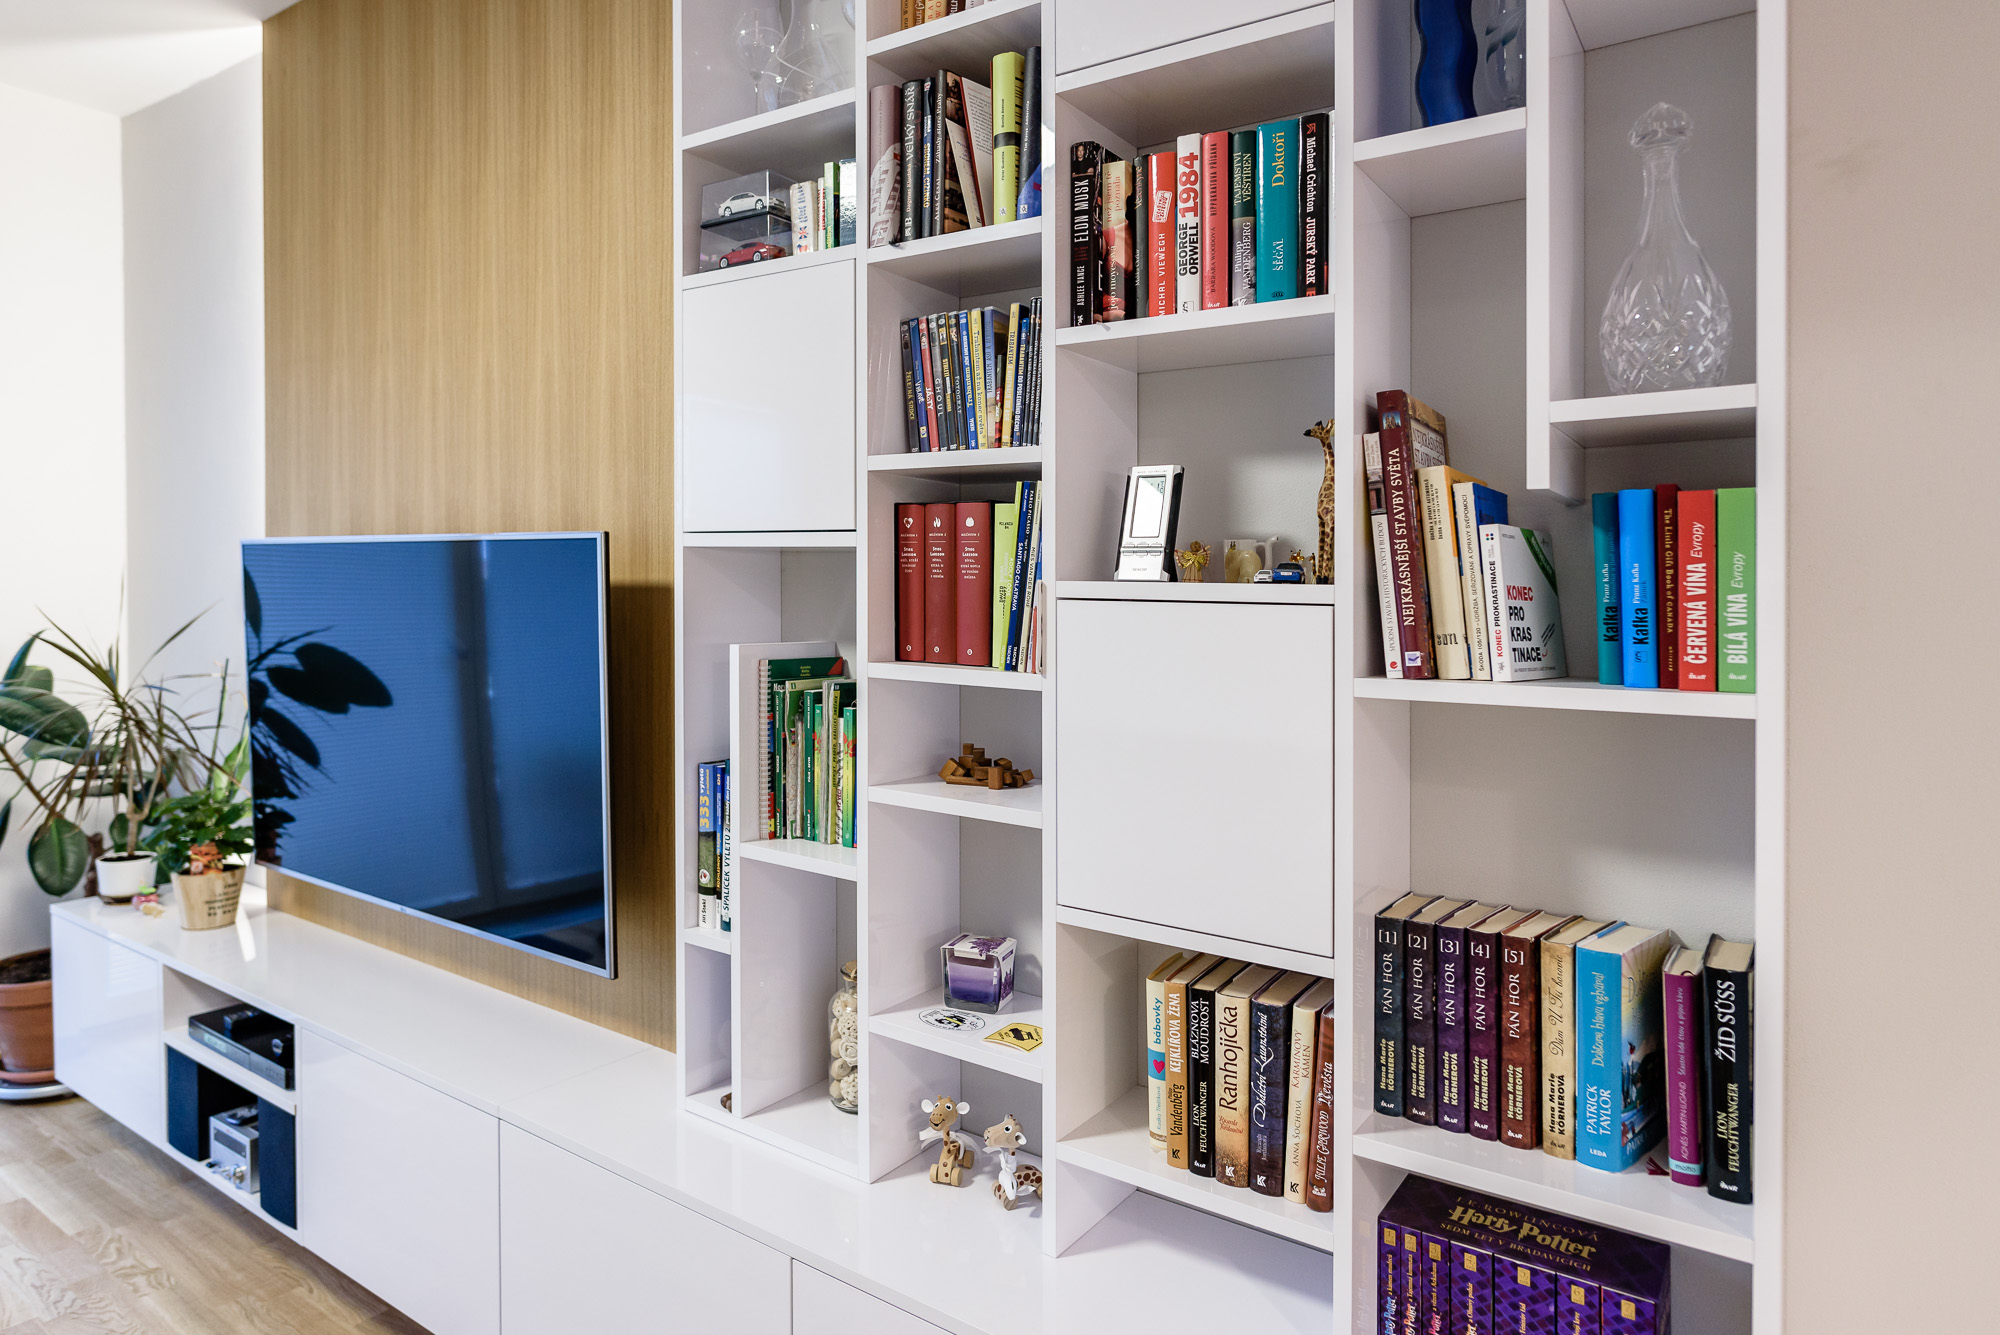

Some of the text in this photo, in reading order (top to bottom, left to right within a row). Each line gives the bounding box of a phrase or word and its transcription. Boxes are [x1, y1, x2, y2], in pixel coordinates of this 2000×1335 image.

[1178, 152, 1199, 218] 1984
[1232, 152, 1242, 206] TAJEMSTVÍ
[1241, 152, 1252, 202] VĚŠTÍREN
[1271, 131, 1286, 188] Doktoři
[1074, 179, 1089, 211] MUSK
[1112, 175, 1123, 211] poznala
[1305, 136, 1318, 285] Michael Crichton JURSKÝ PARK
[1074, 215, 1089, 242] ELON
[1178, 222, 1188, 277] GEORGE
[1188, 222, 1199, 276] ORWELL
[1275, 238, 1284, 272] SEGAL
[1076, 265, 1085, 284] VANCE
[1158, 233, 1166, 316] MICHAL VIEWEGH
[1234, 241, 1243, 273] Philipp
[1242, 222, 1252, 291] VANDENBERG
[1076, 285, 1085, 306] ASHLEE
[1107, 291, 1119, 310] jojo
[973, 330, 981, 372] Trabantem
[1017, 343, 1026, 375] TRABANTEM
[1386, 447, 1416, 626] NEJKRÁSNĚJŠÍ STAVBY SVĚTA
[1011, 542, 1024, 611] SANTIAGO CALATRAVA
[1376, 520, 1396, 652] SPODNÍ STAVBA HISTORICKÝCH BUDOV
[1506, 584, 1534, 602] KONEC
[1632, 585, 1640, 604] Franz
[1664, 508, 1674, 633] The Little Gift Book of CANADA
[1683, 521, 1708, 664] ČERVENÁ VÍNA Evropy
[1487, 560, 1504, 658] KONEC PROKRASTINACE
[1508, 605, 1525, 622] PRO
[1510, 626, 1532, 642] KRAS
[1603, 605, 1619, 642] Kafka
[1632, 607, 1649, 645] Kafka
[1722, 551, 1748, 664] BÍLÁ VÍNA Evropy
[1512, 646, 1543, 663] TINACE
[699, 795, 710, 829] 333
[722, 834, 731, 867] VÝLETŮ
[1379, 929, 1397, 945] [1]
[1408, 935, 1427, 950] [2]
[1440, 940, 1459, 955] [3]
[1470, 942, 1490, 958] [4]
[1504, 949, 1524, 965] [5]
[1383, 952, 1393, 1015] PÁN HOR
[1413, 957, 1423, 1020] PÁN HOR
[1445, 962, 1455, 1026] PÁN HOR
[1551, 954, 1563, 988] borovic
[1152, 997, 1163, 1045] bábovky
[1475, 967, 1486, 1031] PÁN HOR
[1509, 973, 1520, 1039] PÁN HOR
[1714, 979, 1736, 1063] ŽID SÜSS
[1167, 992, 1185, 1073] KEJKLÍŘOVA ŽENA
[1190, 999, 1200, 1059] BLÁZNOVA
[1199, 997, 1210, 1065] MOUDROST
[1549, 1030, 1564, 1057] Dům
[1218, 1006, 1244, 1111] Ranhojička
[1291, 1029, 1303, 1089] KARMÍNOVÝ
[1300, 1044, 1311, 1079] KÁMEN
[1387, 1040, 1395, 1091] KÖRNEROVÁ
[1450, 1052, 1458, 1105] KÖRNEROVÁ
[1170, 1083, 1185, 1136] Vandenberg
[1199, 1081, 1208, 1153] FEUCHTWANGER
[1250, 1073, 1268, 1127] Dědictví
[1515, 1066, 1523, 1121] KÖRNEROVÁ
[1555, 1074, 1565, 1136] KÖRNEROVÁ
[1586, 1083, 1598, 1135] PATRICK
[1599, 1088, 1611, 1136] TAYLOR
[1292, 1099, 1303, 1167] ANNA ŠOCHOVÁ
[1314, 1061, 1333, 1183] JULIE GARWOOD Nevěsta
[1716, 1110, 1727, 1140] LION
[1727, 1082, 1739, 1173] FEUCHTWANGER
[1589, 1148, 1607, 1159] LEDA
[1440, 1222, 1471, 1236] SEDM
[1473, 1232, 1495, 1243] LET
[1448, 1205, 1597, 1260] Harry Potter
